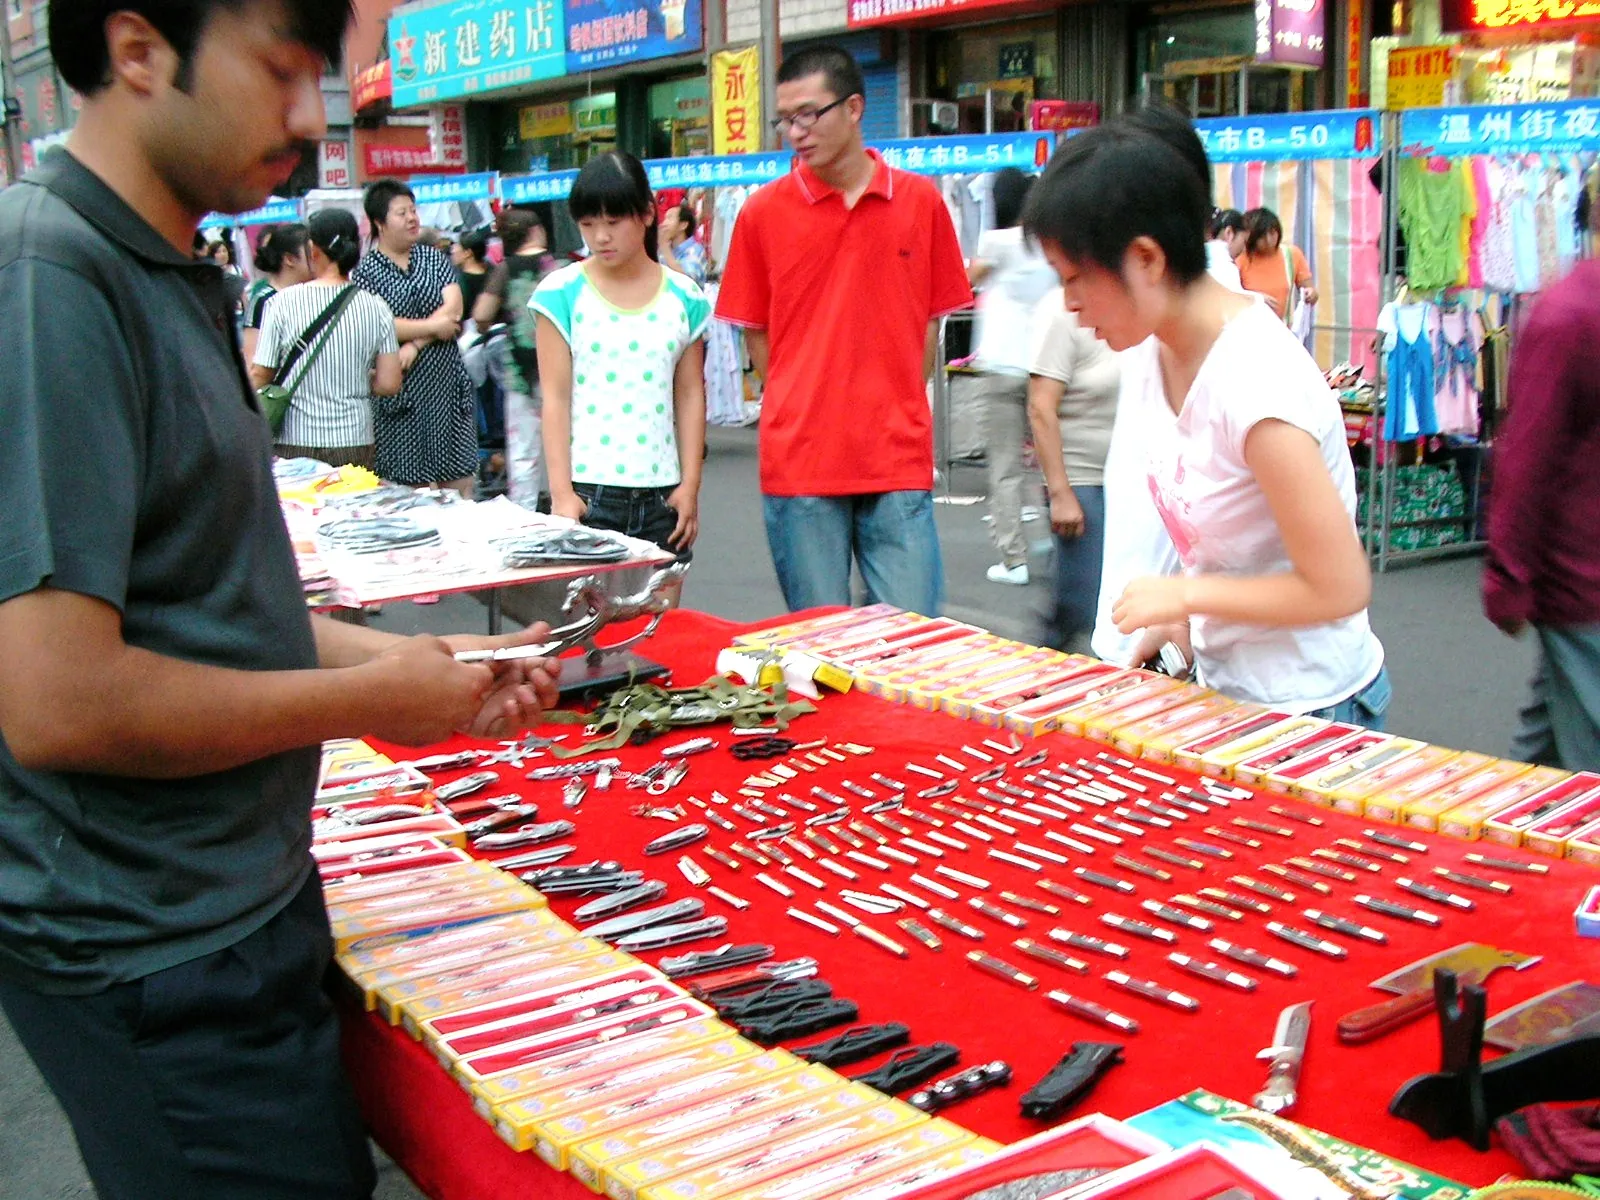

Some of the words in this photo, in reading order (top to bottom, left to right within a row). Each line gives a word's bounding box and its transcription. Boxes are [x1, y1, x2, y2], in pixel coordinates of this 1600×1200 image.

[423, 0, 554, 76] 新建药店
[1438, 106, 1600, 144] 温州街夜
[325, 143, 348, 186] 网吧
[649, 160, 777, 184] 温州街夜市B-48
